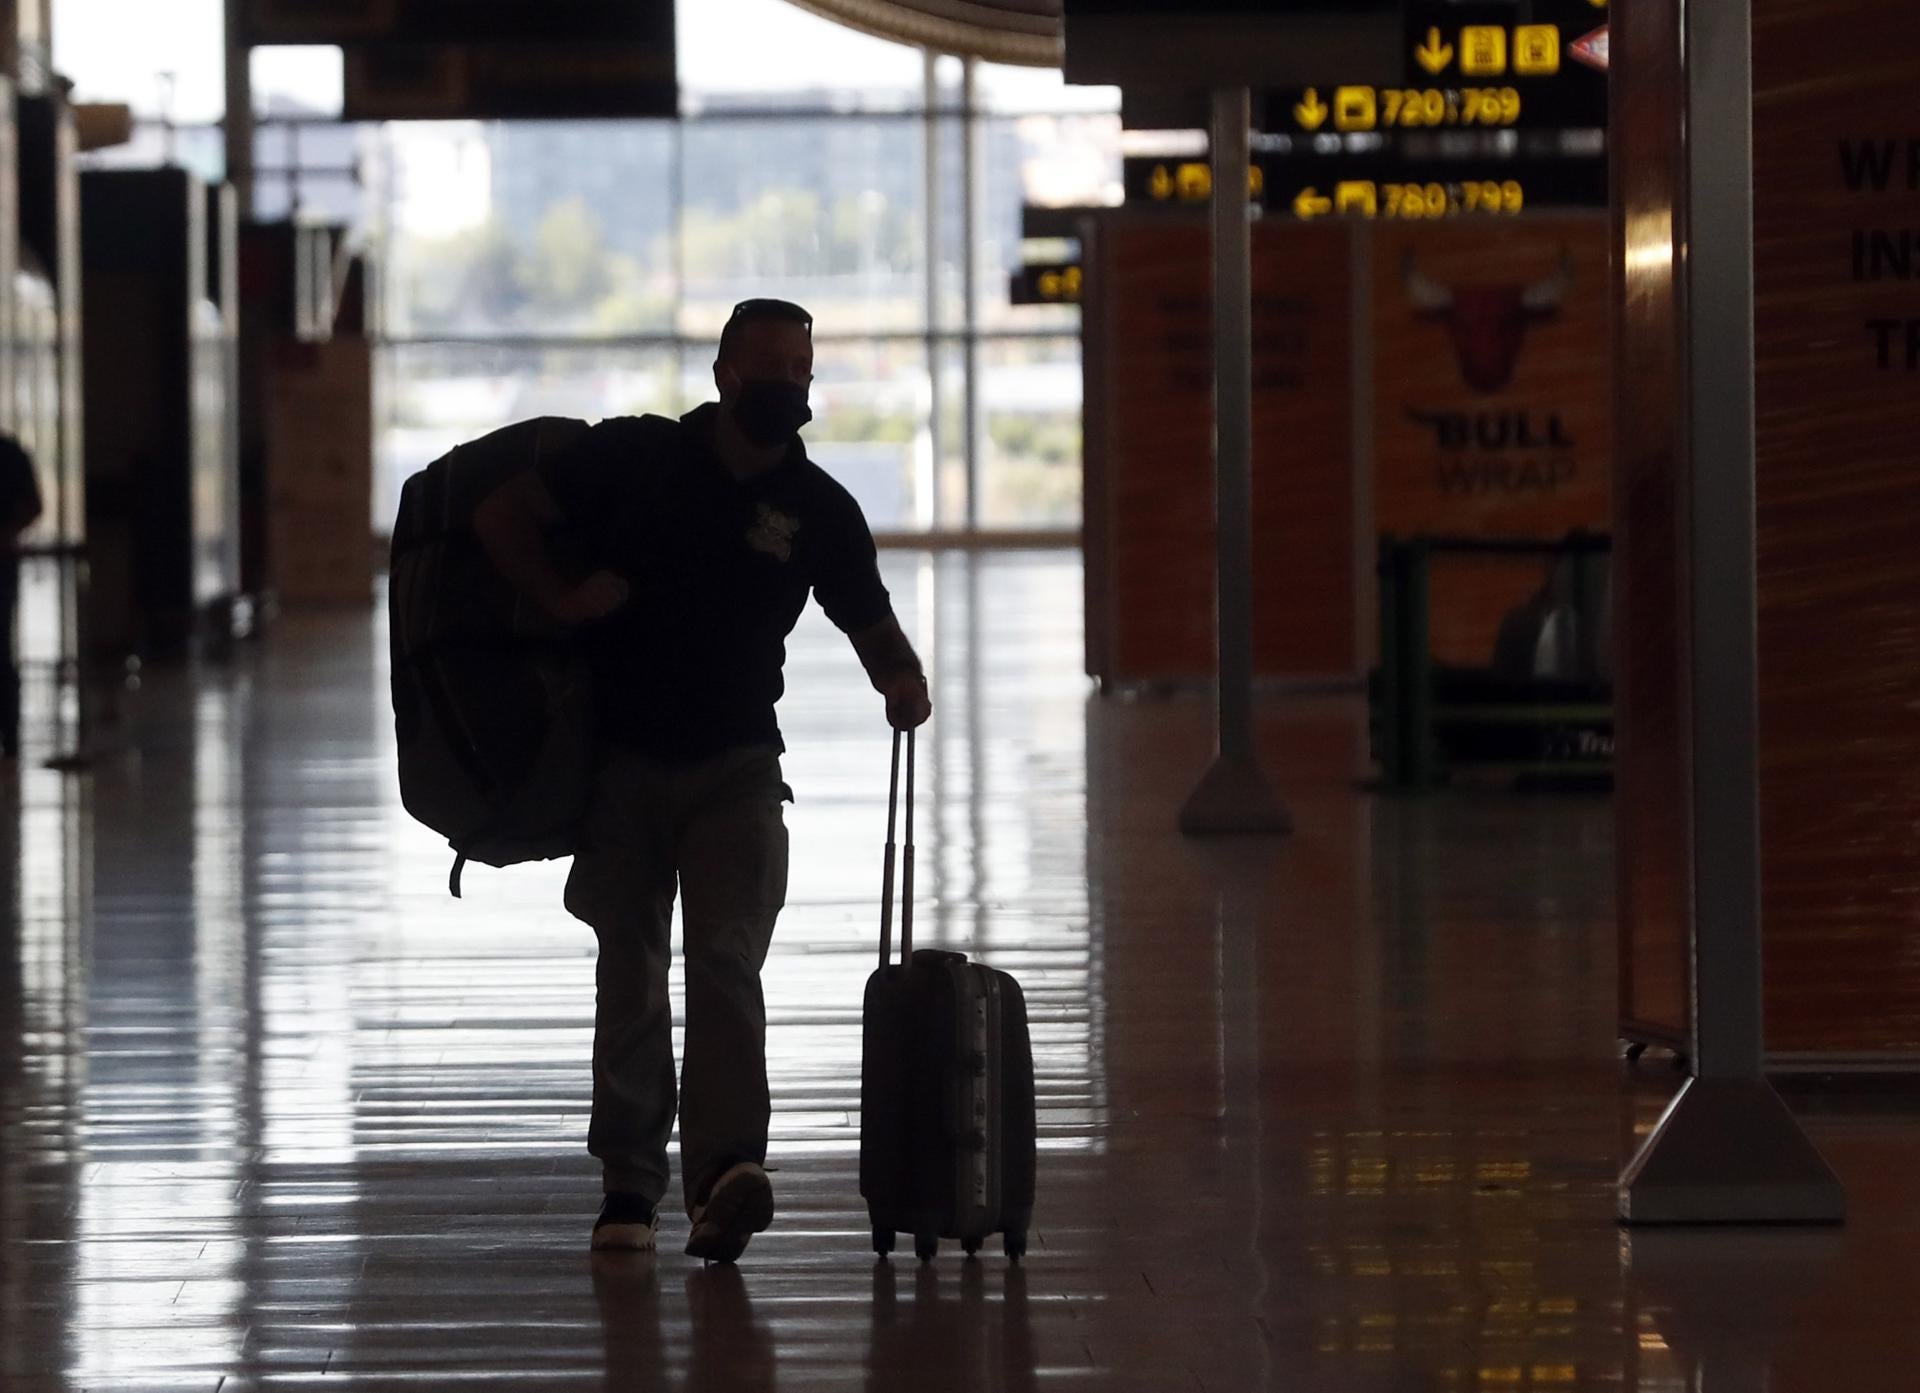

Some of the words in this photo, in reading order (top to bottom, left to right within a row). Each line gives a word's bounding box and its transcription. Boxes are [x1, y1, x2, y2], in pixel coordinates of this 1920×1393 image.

[1380, 88, 1445, 127] 720
[1460, 86, 1521, 126] 769
[1852, 229, 1920, 281] IN
[1430, 410, 1576, 450] BULL
[1435, 458, 1578, 497] WRAP
